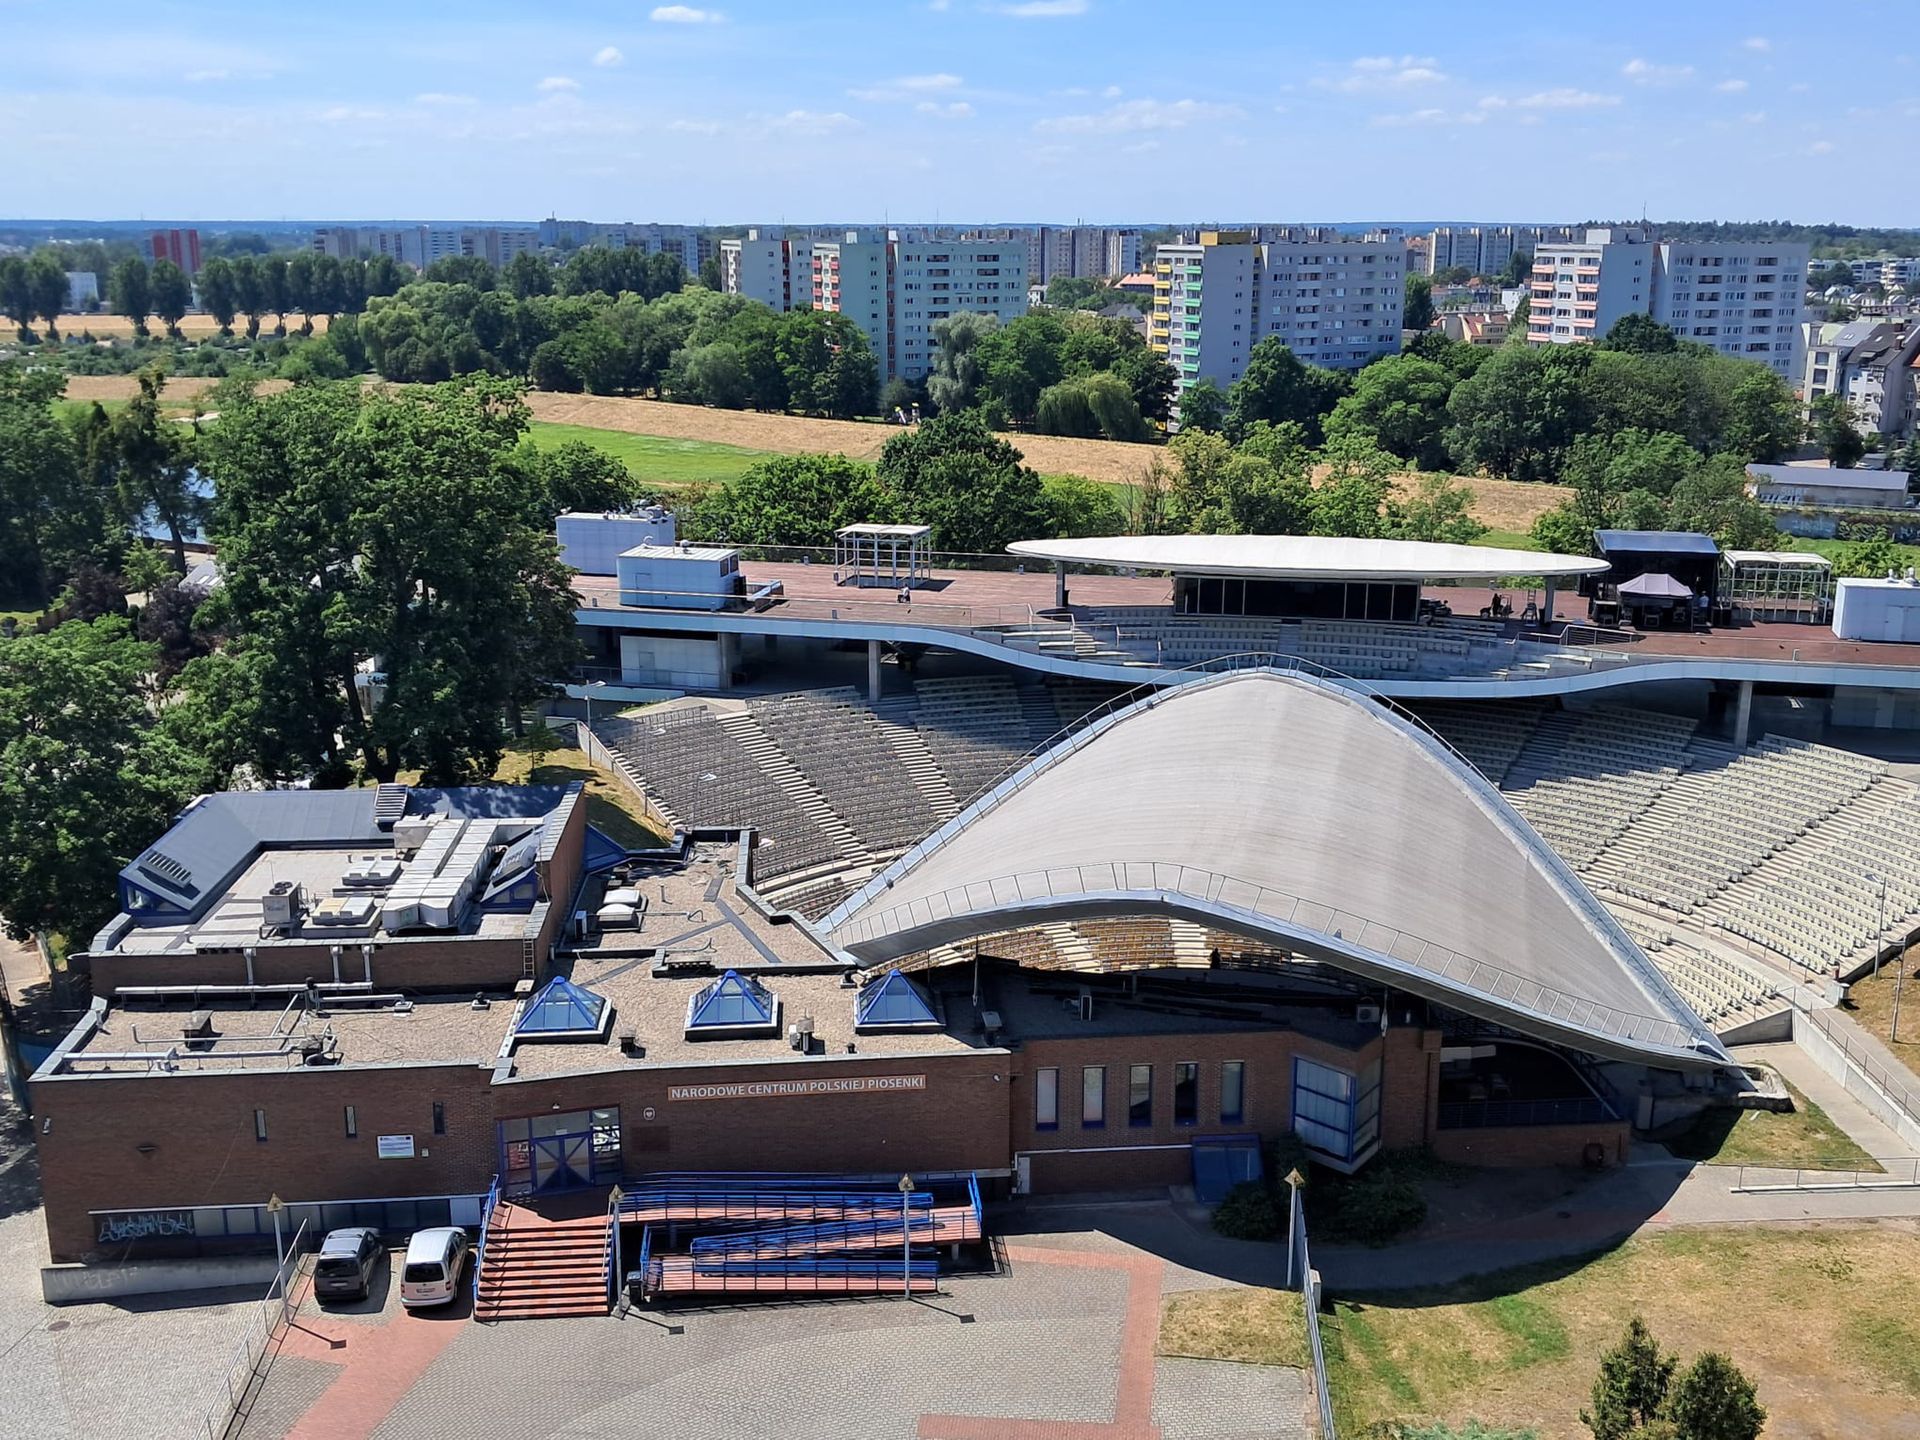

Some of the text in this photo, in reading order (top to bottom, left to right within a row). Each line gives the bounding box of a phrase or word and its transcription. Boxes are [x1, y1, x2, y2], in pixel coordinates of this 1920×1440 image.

[671, 1077, 923, 1099] NARODOWE CENTRUM POLSKIEJ PIOSENKI
